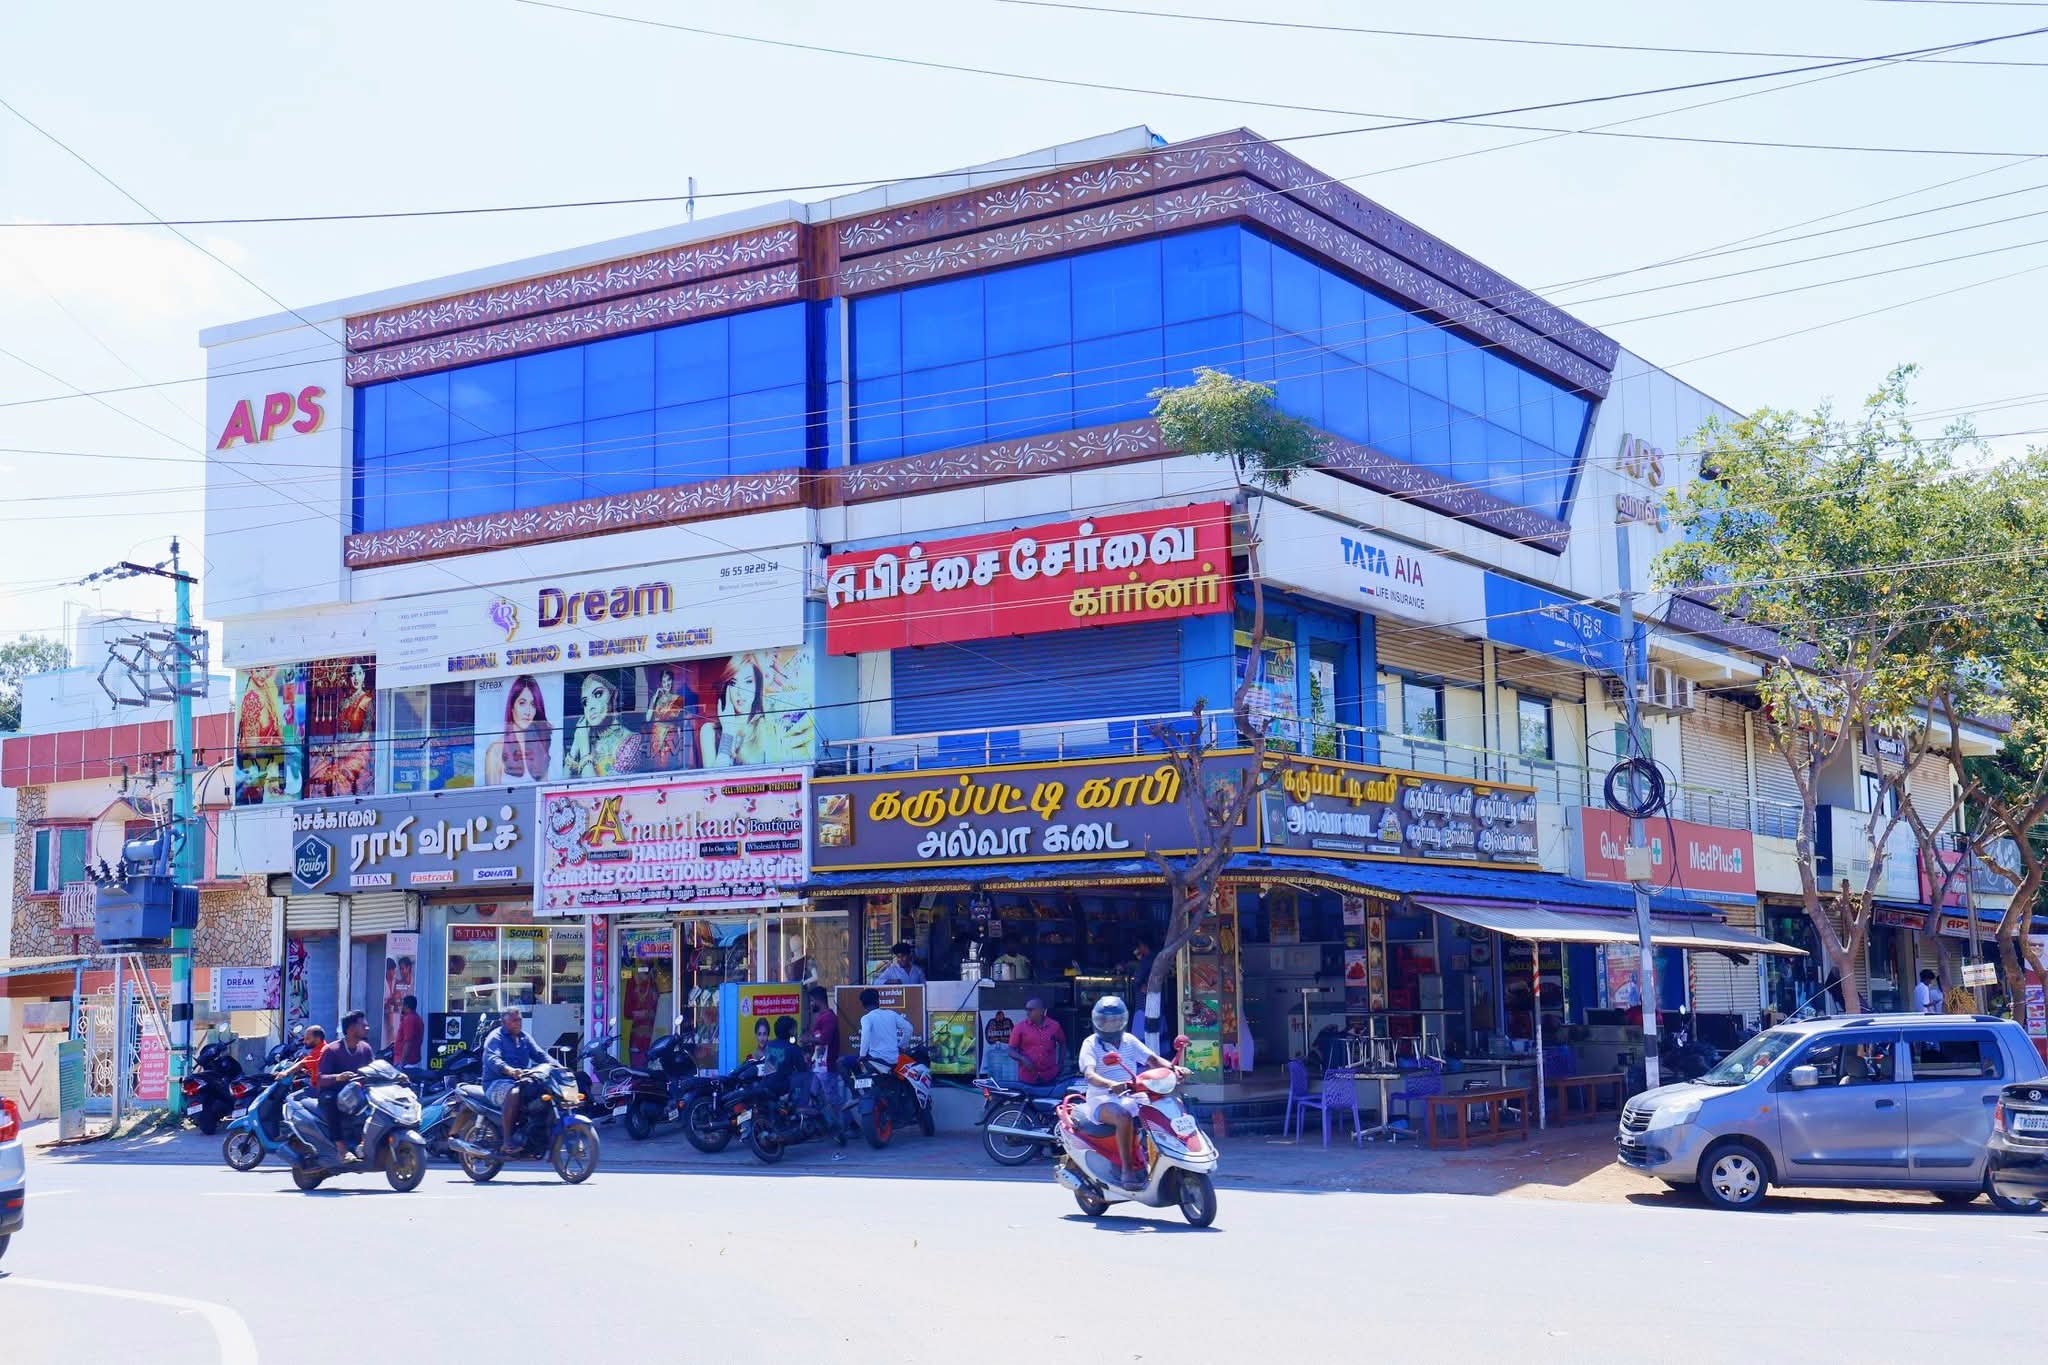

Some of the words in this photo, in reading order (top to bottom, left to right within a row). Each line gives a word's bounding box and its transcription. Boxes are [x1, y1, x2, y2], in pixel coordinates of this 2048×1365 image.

[217, 385, 325, 450] APS
[1616, 433, 1665, 487] APS
[1008, 522, 1196, 581] சேர்வை
[1340, 536, 1389, 577] TATA
[1394, 555, 1425, 588] AIA
[538, 581, 673, 628] Dream
[1069, 562, 1221, 617] கார்னர்
[1375, 587, 1389, 601] LIFE
[1390, 591, 1425, 610] INSURANCE
[448, 653, 499, 673] BRIDAL
[506, 645, 561, 665] STUDIO
[568, 643, 581, 659] &
[589, 634, 648, 657] BEAUTY
[656, 627, 713, 649] SALON
[479, 680, 503, 690] streax
[869, 775, 1064, 827] கருப்பட்டி
[1077, 765, 1181, 810] காபி
[1284, 765, 1363, 807] கருப்பட்டி
[1365, 774, 1398, 803] காபி
[292, 807, 376, 832] செக்காலை
[584, 795, 746, 844] Anantikaas
[749, 817, 801, 835] Boutique
[1287, 802, 1342, 835] அல்வா
[1342, 813, 1378, 838] கடை
[351, 815, 415, 872] ராபி
[419, 805, 517, 860] வாட்ச்
[632, 841, 698, 862] HARISH
[917, 823, 1031, 858] அல்வா
[1042, 823, 1130, 853] கடை
[297, 854, 326, 877] Rauby
[1689, 842, 1734, 872] MedPlus
[355, 875, 387, 885] TITAN
[411, 871, 454, 883] fastrack
[477, 869, 514, 879] SONATA
[543, 866, 616, 888] Cosmetics
[616, 861, 713, 884] COLLECTIONS
[465, 929, 494, 938] TITAN
[509, 928, 544, 938] SONATA
[227, 978, 254, 986] DREAM
